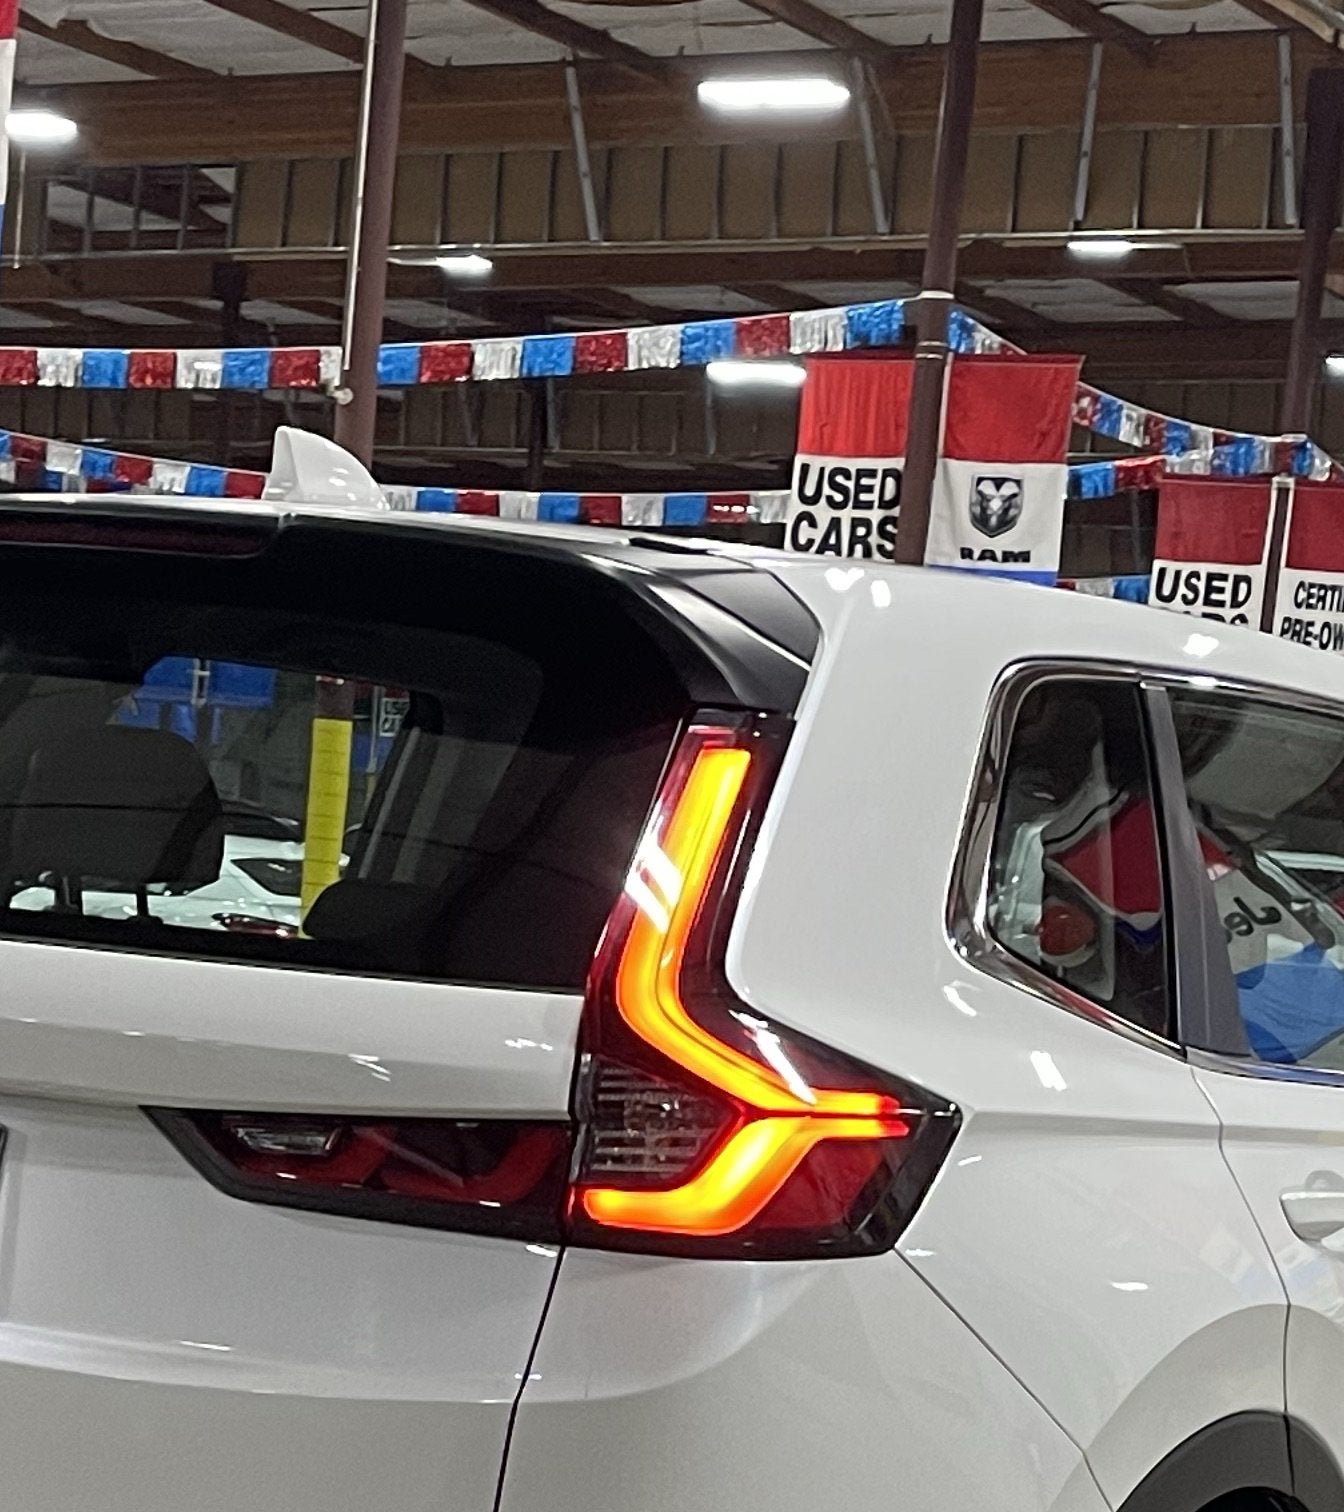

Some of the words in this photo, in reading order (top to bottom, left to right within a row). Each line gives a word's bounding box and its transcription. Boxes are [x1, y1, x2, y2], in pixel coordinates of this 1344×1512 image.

[797, 463, 902, 510] USED
[790, 511, 898, 559] CARS
[959, 546, 1031, 563] RAM
[1155, 567, 1252, 609] USED
